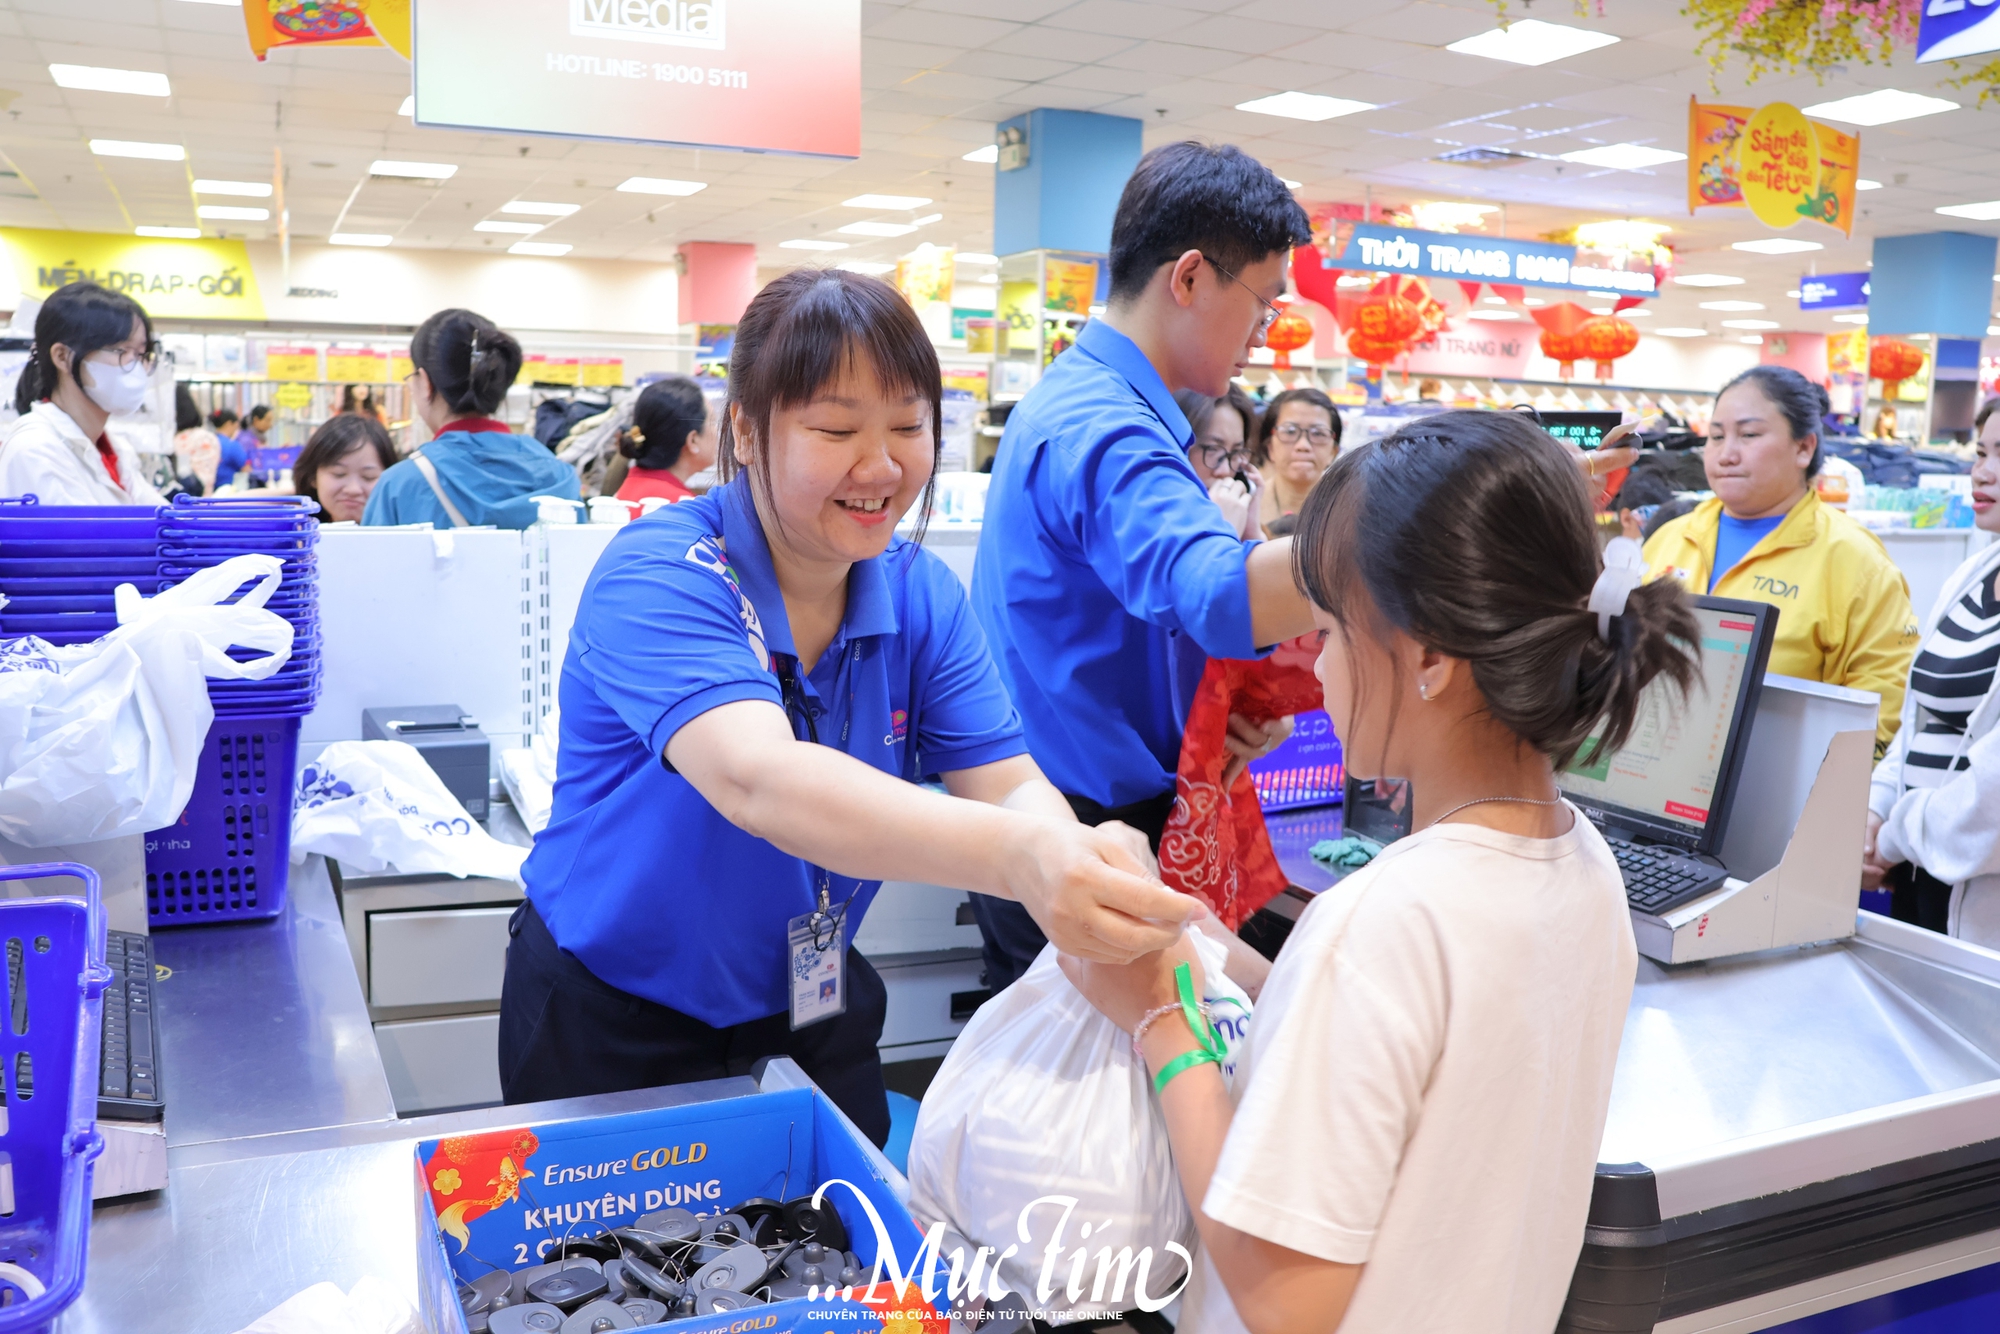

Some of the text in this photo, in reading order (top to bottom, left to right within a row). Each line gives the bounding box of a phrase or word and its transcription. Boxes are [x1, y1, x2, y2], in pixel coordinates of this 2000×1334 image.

[546, 52, 748, 89] HOTLINE: 1900 5111
[1427, 244, 1511, 278] TRANG
[1447, 337, 1497, 356] TRANG
[543, 1142, 708, 1186] Ensure GOLD
[524, 1192, 637, 1230] KHUYÊN
[645, 1179, 721, 1210] DÙNG
[513, 1243, 529, 1264] 2
[730, 1315, 778, 1333] GOLD
